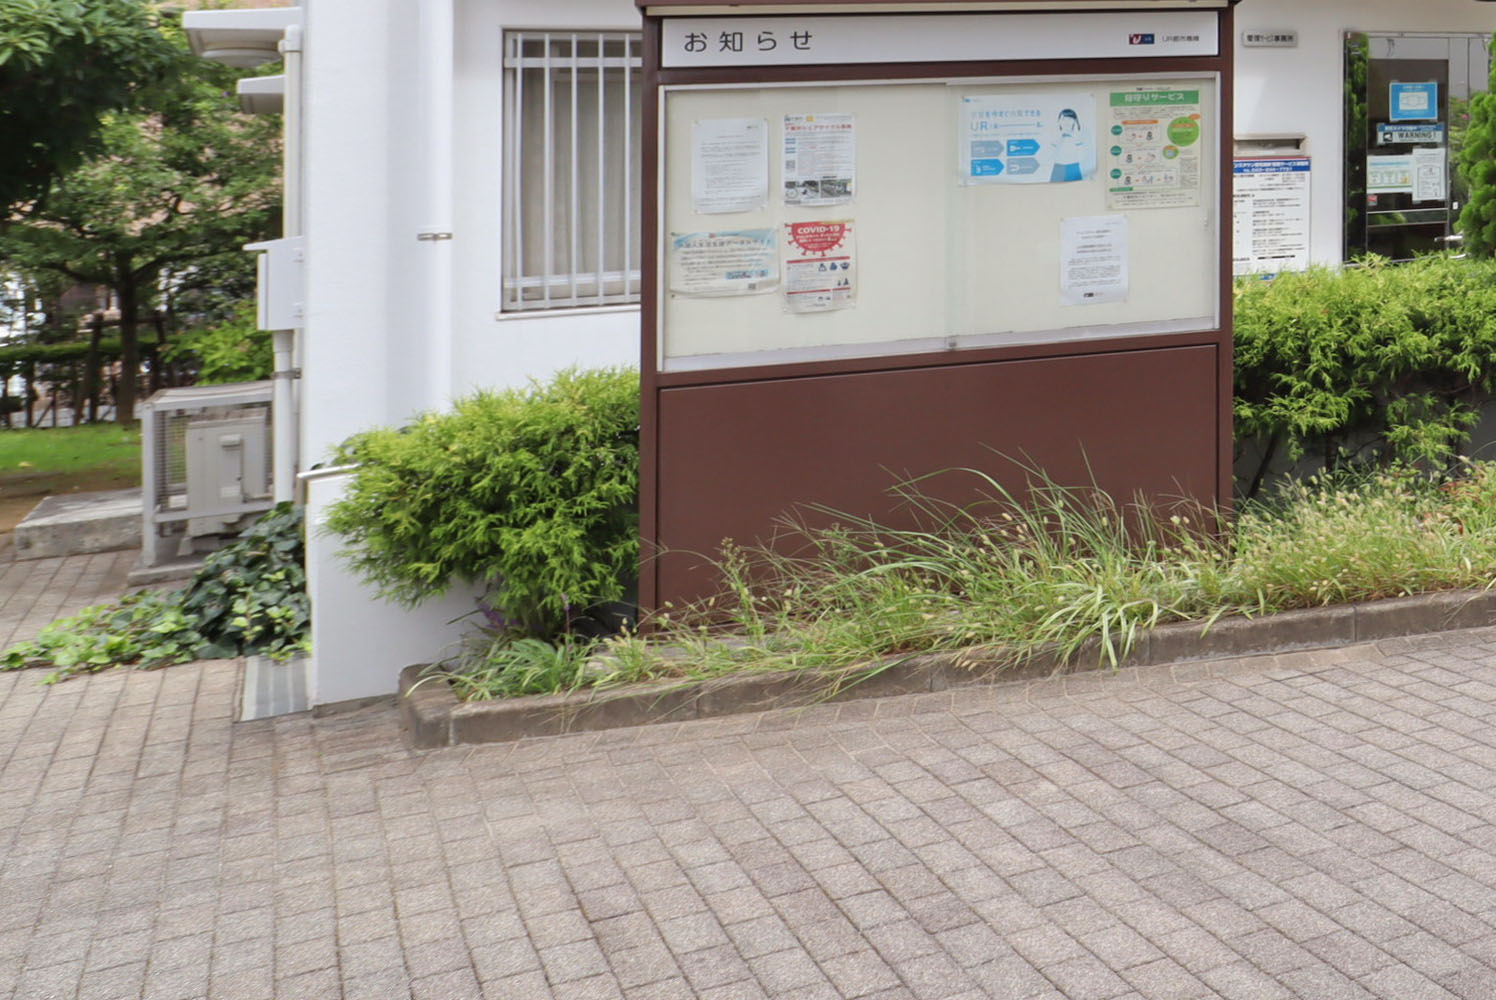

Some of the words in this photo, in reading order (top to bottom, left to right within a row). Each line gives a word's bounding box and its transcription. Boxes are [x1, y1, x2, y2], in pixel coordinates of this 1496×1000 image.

[684, 31, 813, 53] お知らせ
[797, 225, 841, 235] COVID-19
